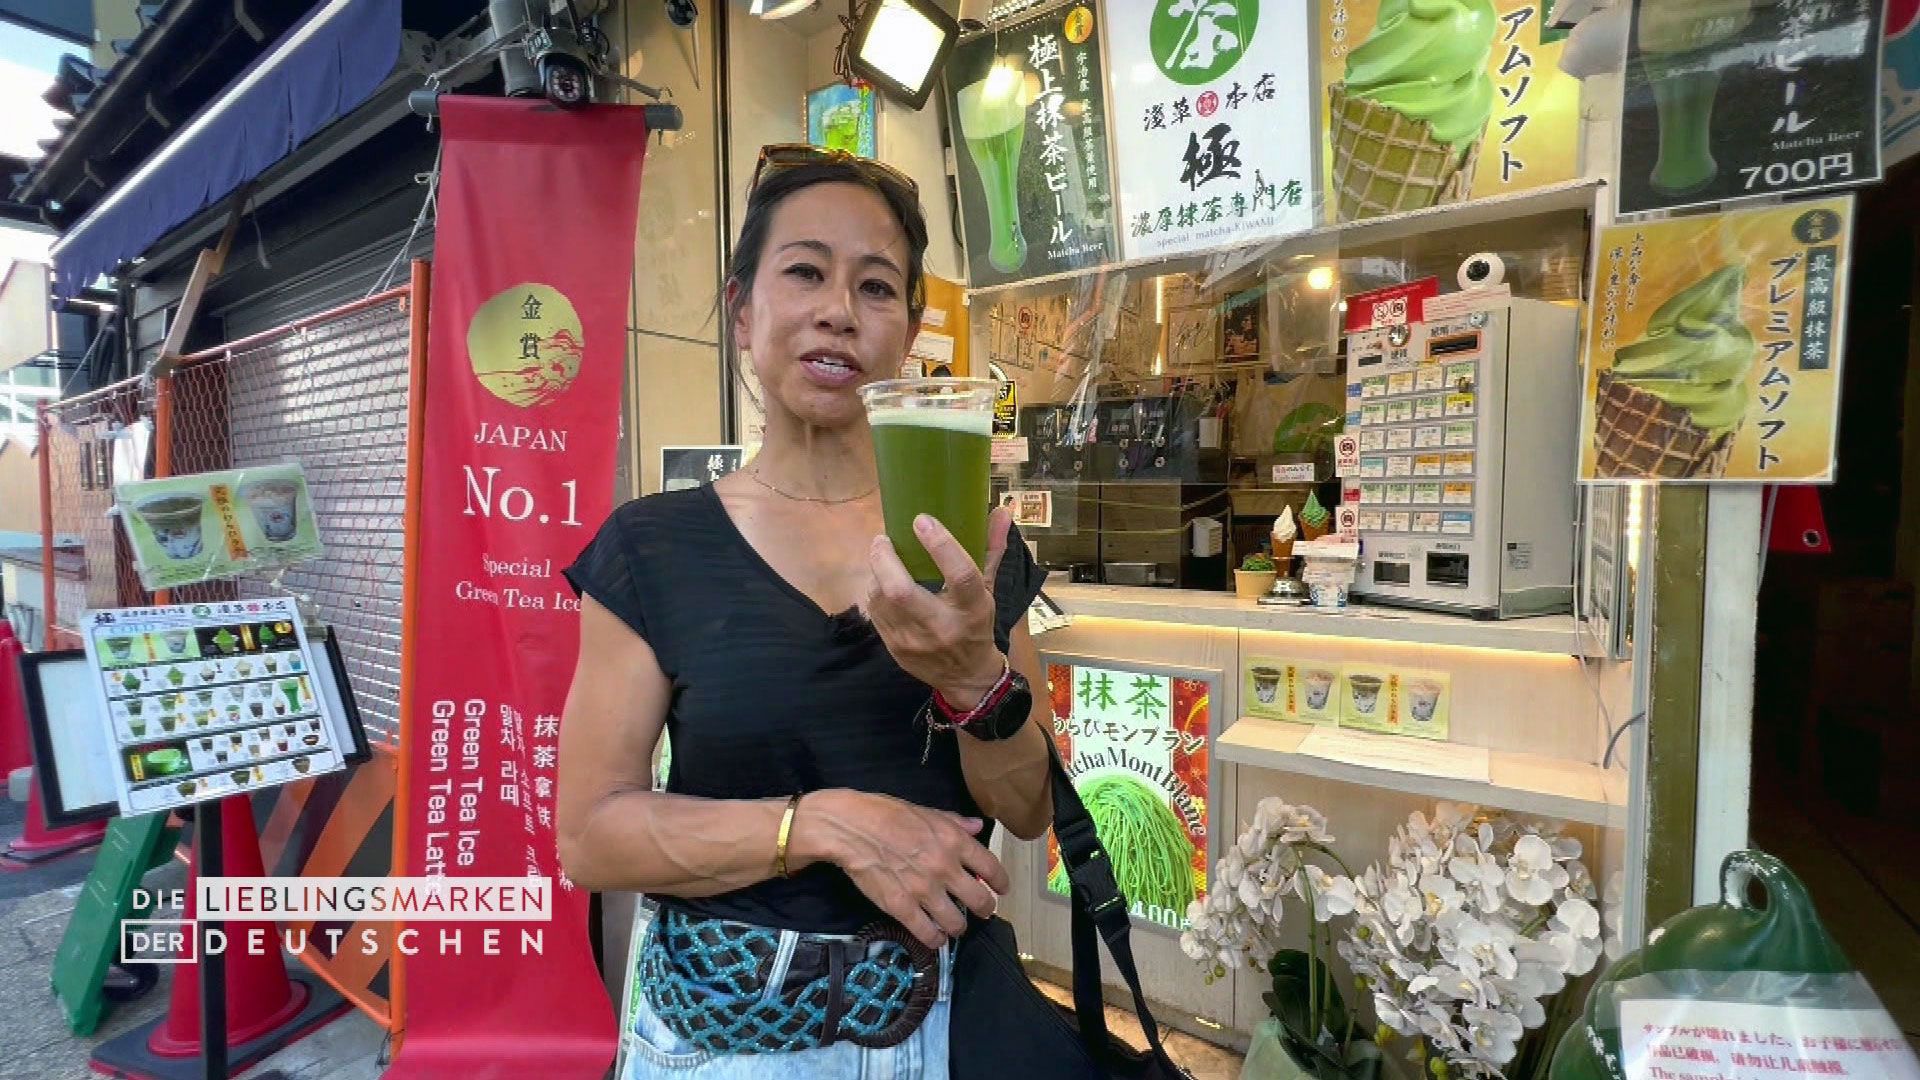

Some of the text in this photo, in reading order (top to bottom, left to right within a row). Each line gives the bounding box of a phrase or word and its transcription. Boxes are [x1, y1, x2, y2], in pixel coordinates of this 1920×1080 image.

[1500, 7, 1534, 181] アムソフト
[1027, 33, 1073, 244] 極上抹茶ビール
[1180, 122, 1243, 191] 極
[1771, 131, 1862, 151] Matcha Beer
[1738, 153, 1854, 190] 700円
[1048, 246, 1080, 259] Matcha
[1156, 234, 1190, 249] special
[1757, 251, 1803, 471] プレミアムソフト
[474, 422, 569, 452] JAPAN
[463, 464, 583, 527] No.1
[482, 553, 552, 578] Special
[503, 588, 545, 610] Tea
[1077, 670, 1168, 720] 抹茶
[430, 700, 456, 772] Green
[427, 778, 452, 824] Tea
[457, 698, 486, 866] Green Tea Ice
[1064, 746, 1207, 836] tcha Mont Blanc
